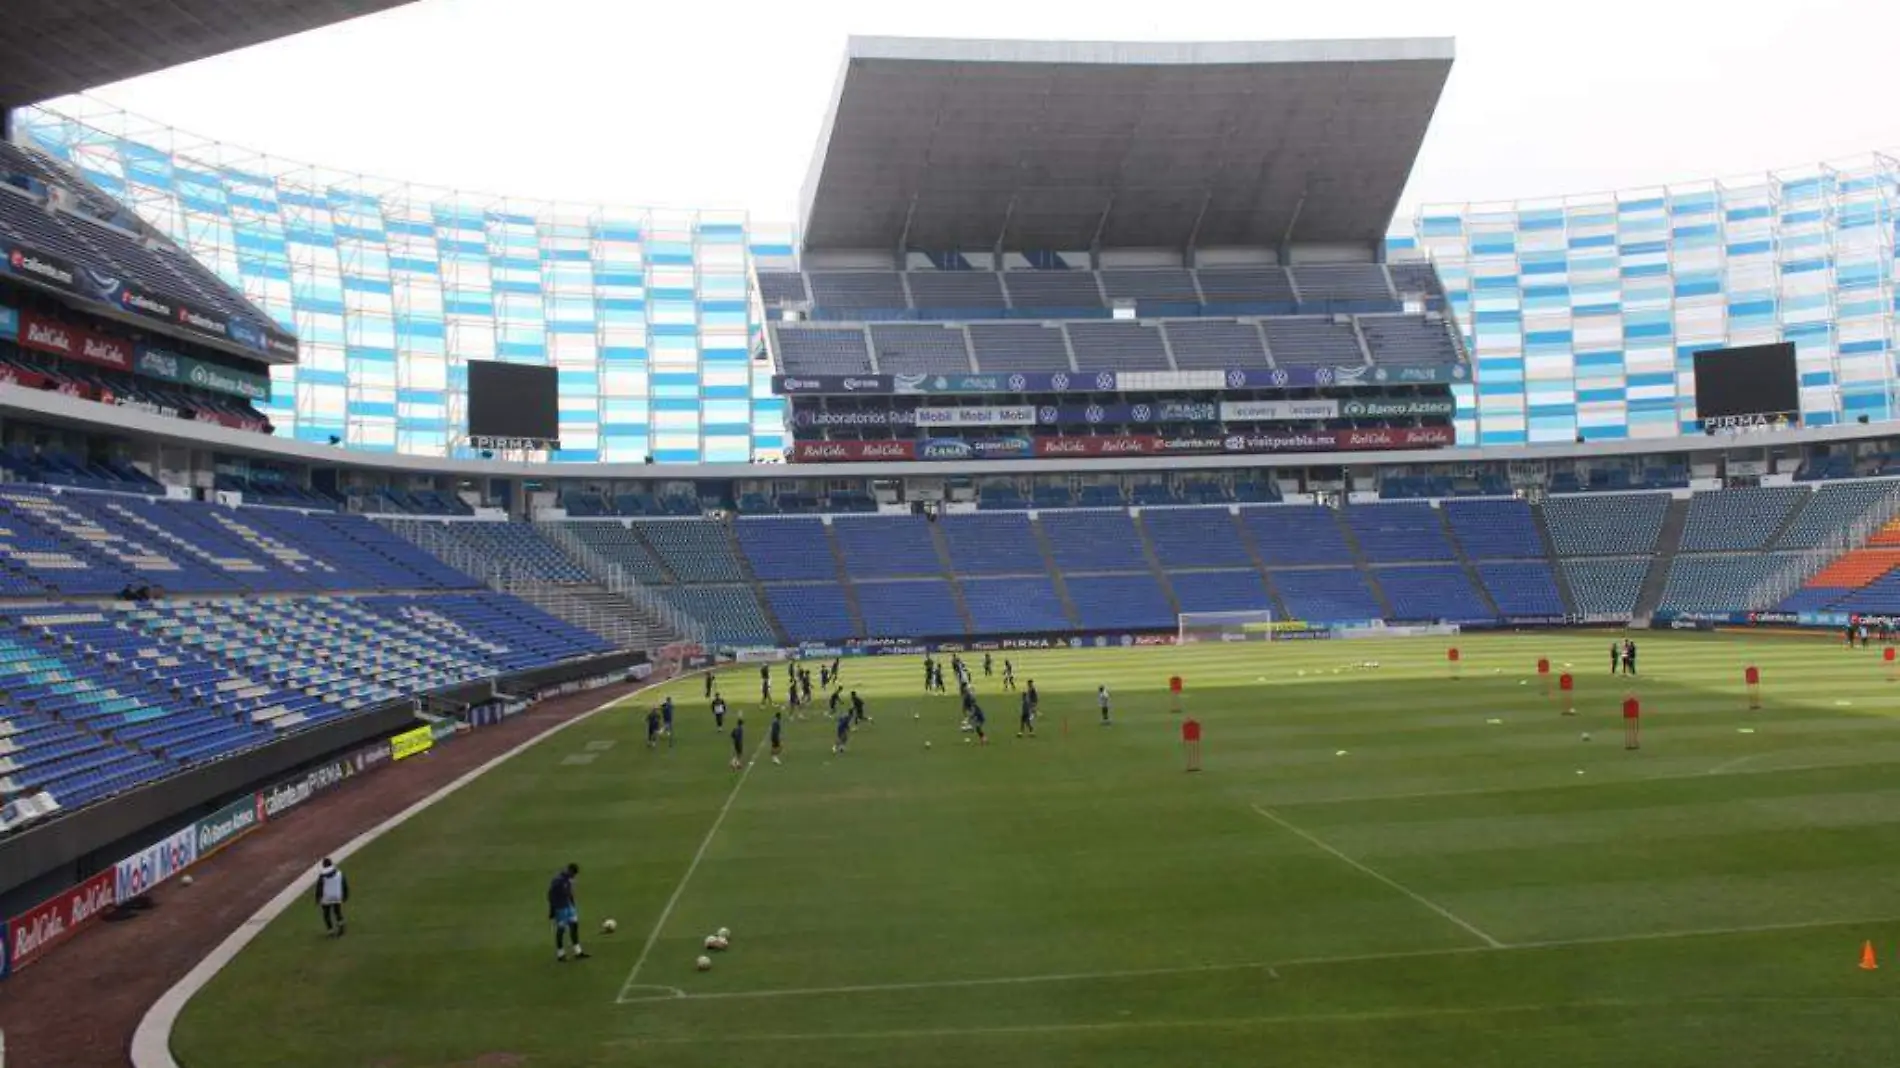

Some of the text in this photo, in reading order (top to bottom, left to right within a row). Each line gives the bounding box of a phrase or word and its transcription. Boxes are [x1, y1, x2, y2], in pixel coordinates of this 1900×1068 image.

[1366, 401, 1452, 414] Banco Azteca
[812, 411, 886, 424] Laboratorios
[919, 408, 1032, 422] Mobil Mobil Mobil
[1704, 412, 1767, 429] PIRMA
[478, 436, 535, 451] PIRMA
[119, 827, 192, 898] Mobil Mobil
